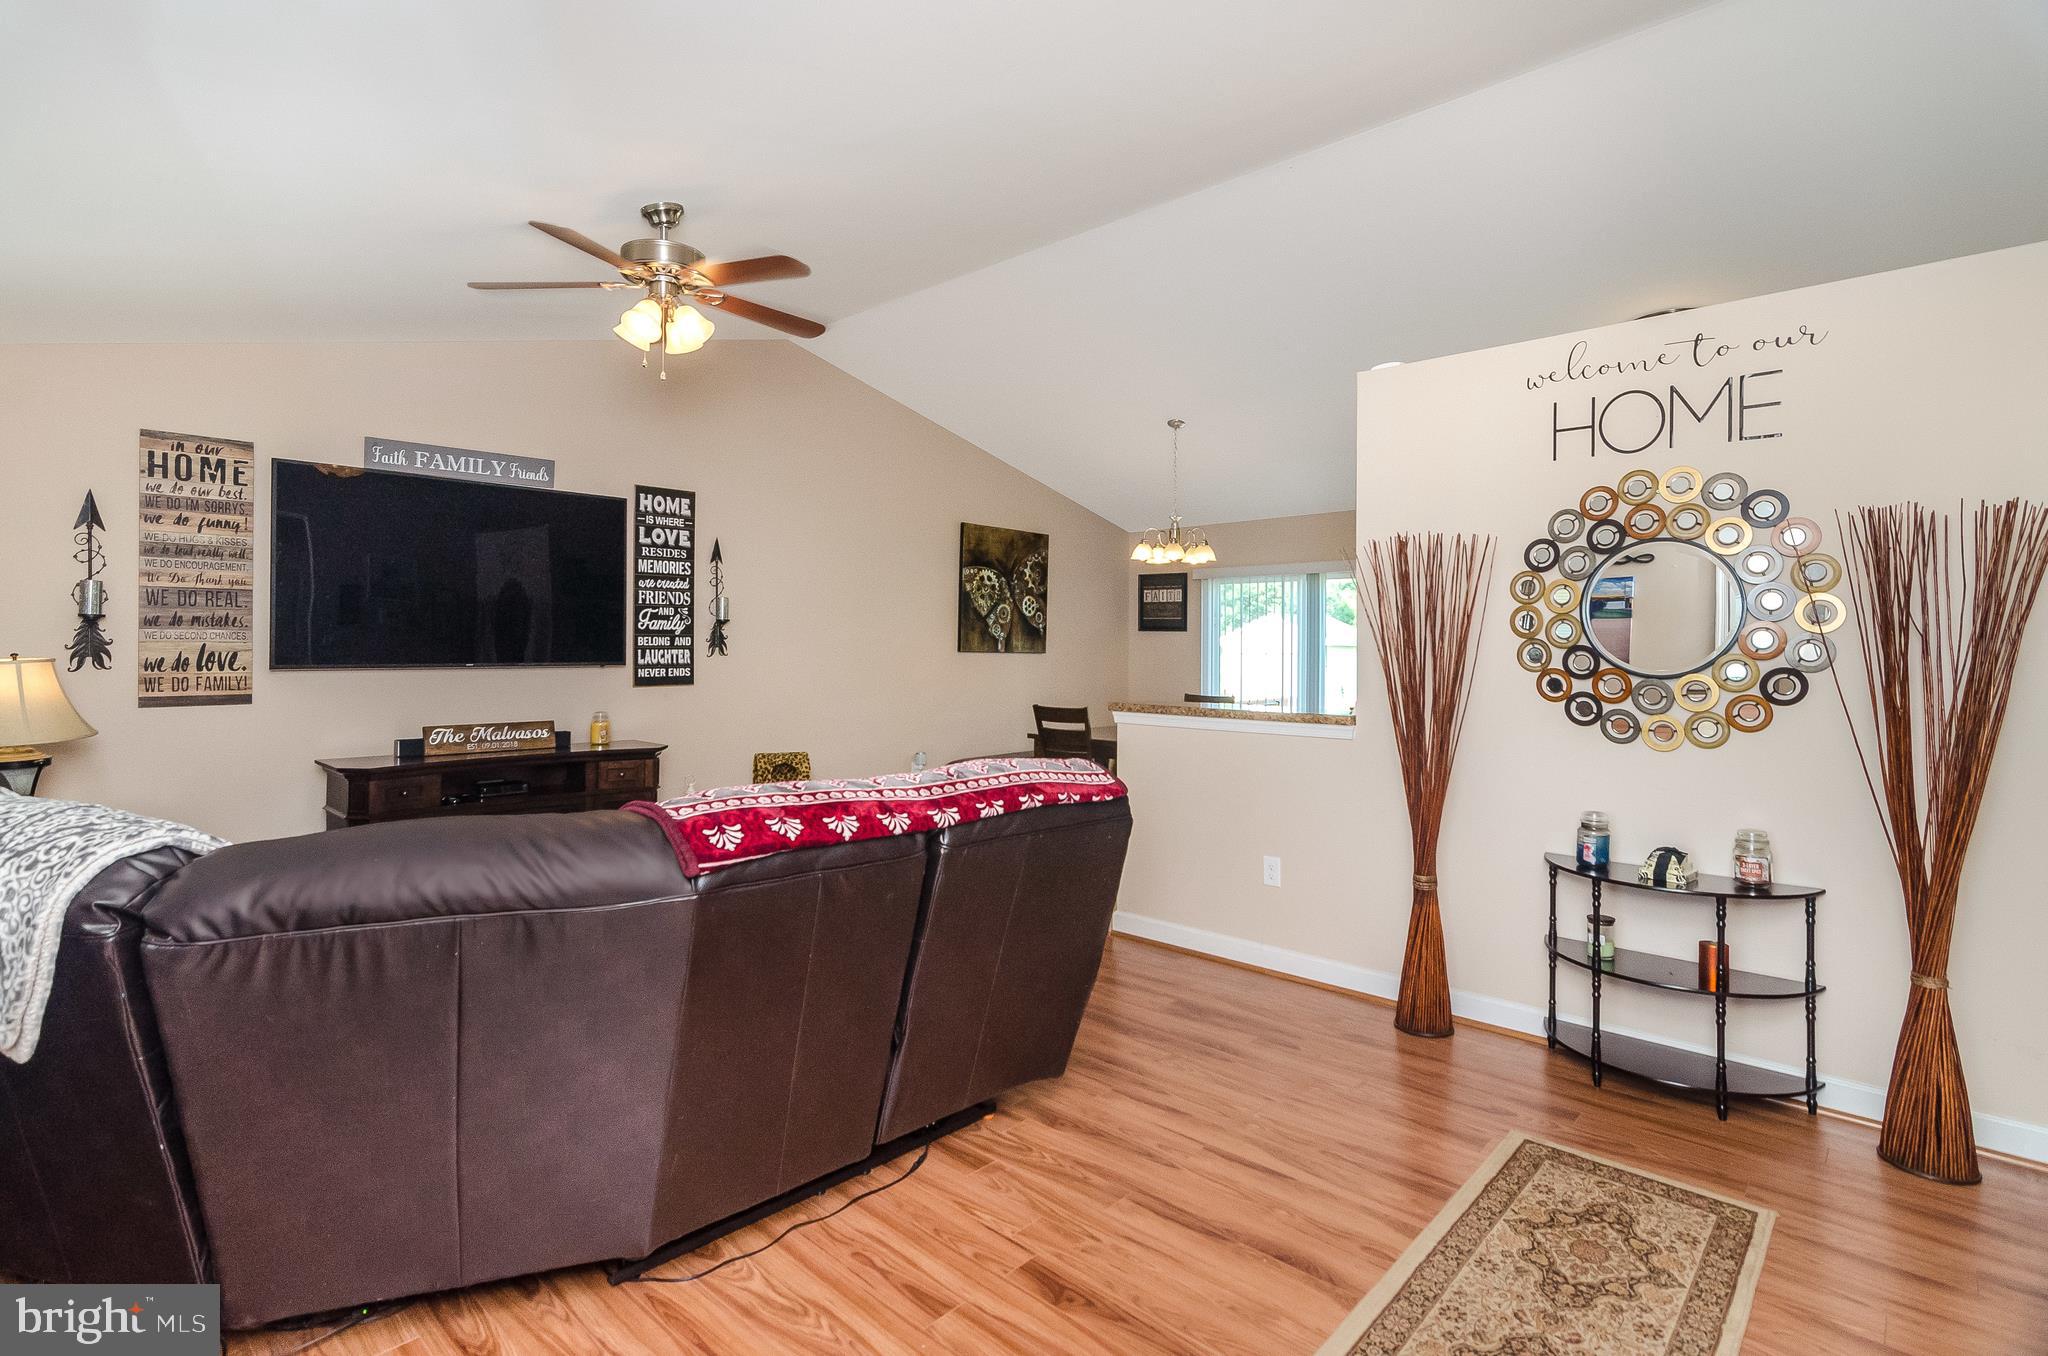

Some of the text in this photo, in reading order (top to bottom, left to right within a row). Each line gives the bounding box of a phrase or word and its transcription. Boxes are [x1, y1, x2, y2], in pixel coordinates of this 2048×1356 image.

[1527, 325, 1829, 390] welcome to our
[1552, 369, 1783, 461] HOME
[170, 441, 224, 456] in our
[147, 450, 249, 486] HOME
[372, 445, 549, 482] Faith FAMILY Friends
[145, 481, 247, 500] we do our best.
[145, 495, 161, 508] WE
[166, 497, 181, 509] DO
[639, 493, 691, 517] HOME
[143, 513, 248, 534] we do funny!
[646, 515, 685, 527] IS WHERE
[144, 532, 160, 541] WE
[162, 533, 176, 543] DO
[638, 526, 691, 548] LOVE
[143, 545, 155, 554] we
[641, 546, 687, 559] RESIDES
[144, 558, 158, 568] WE
[160, 559, 173, 569] DO
[638, 559, 691, 575] MEMORIES
[147, 572, 160, 583] We
[168, 572, 187, 584] Do
[638, 577, 690, 589] are created
[146, 588, 248, 608] WE DO REAL.
[638, 590, 691, 606] FRIENDS
[1144, 590, 1182, 602] FAITH
[143, 611, 248, 628] we do mistakes.
[658, 607, 675, 616] AND
[638, 608, 686, 635] Family
[144, 631, 158, 640] WE
[159, 631, 172, 640] DO
[175, 631, 208, 640] SECOND
[637, 636, 691, 646] BELONG AND
[143, 642, 247, 672] we do love.
[637, 649, 691, 665] LAUGHTER
[637, 667, 691, 678] NEVER ENDS
[144, 675, 248, 692] WE DO FAMILY!
[429, 726, 551, 745] The Malvasos
